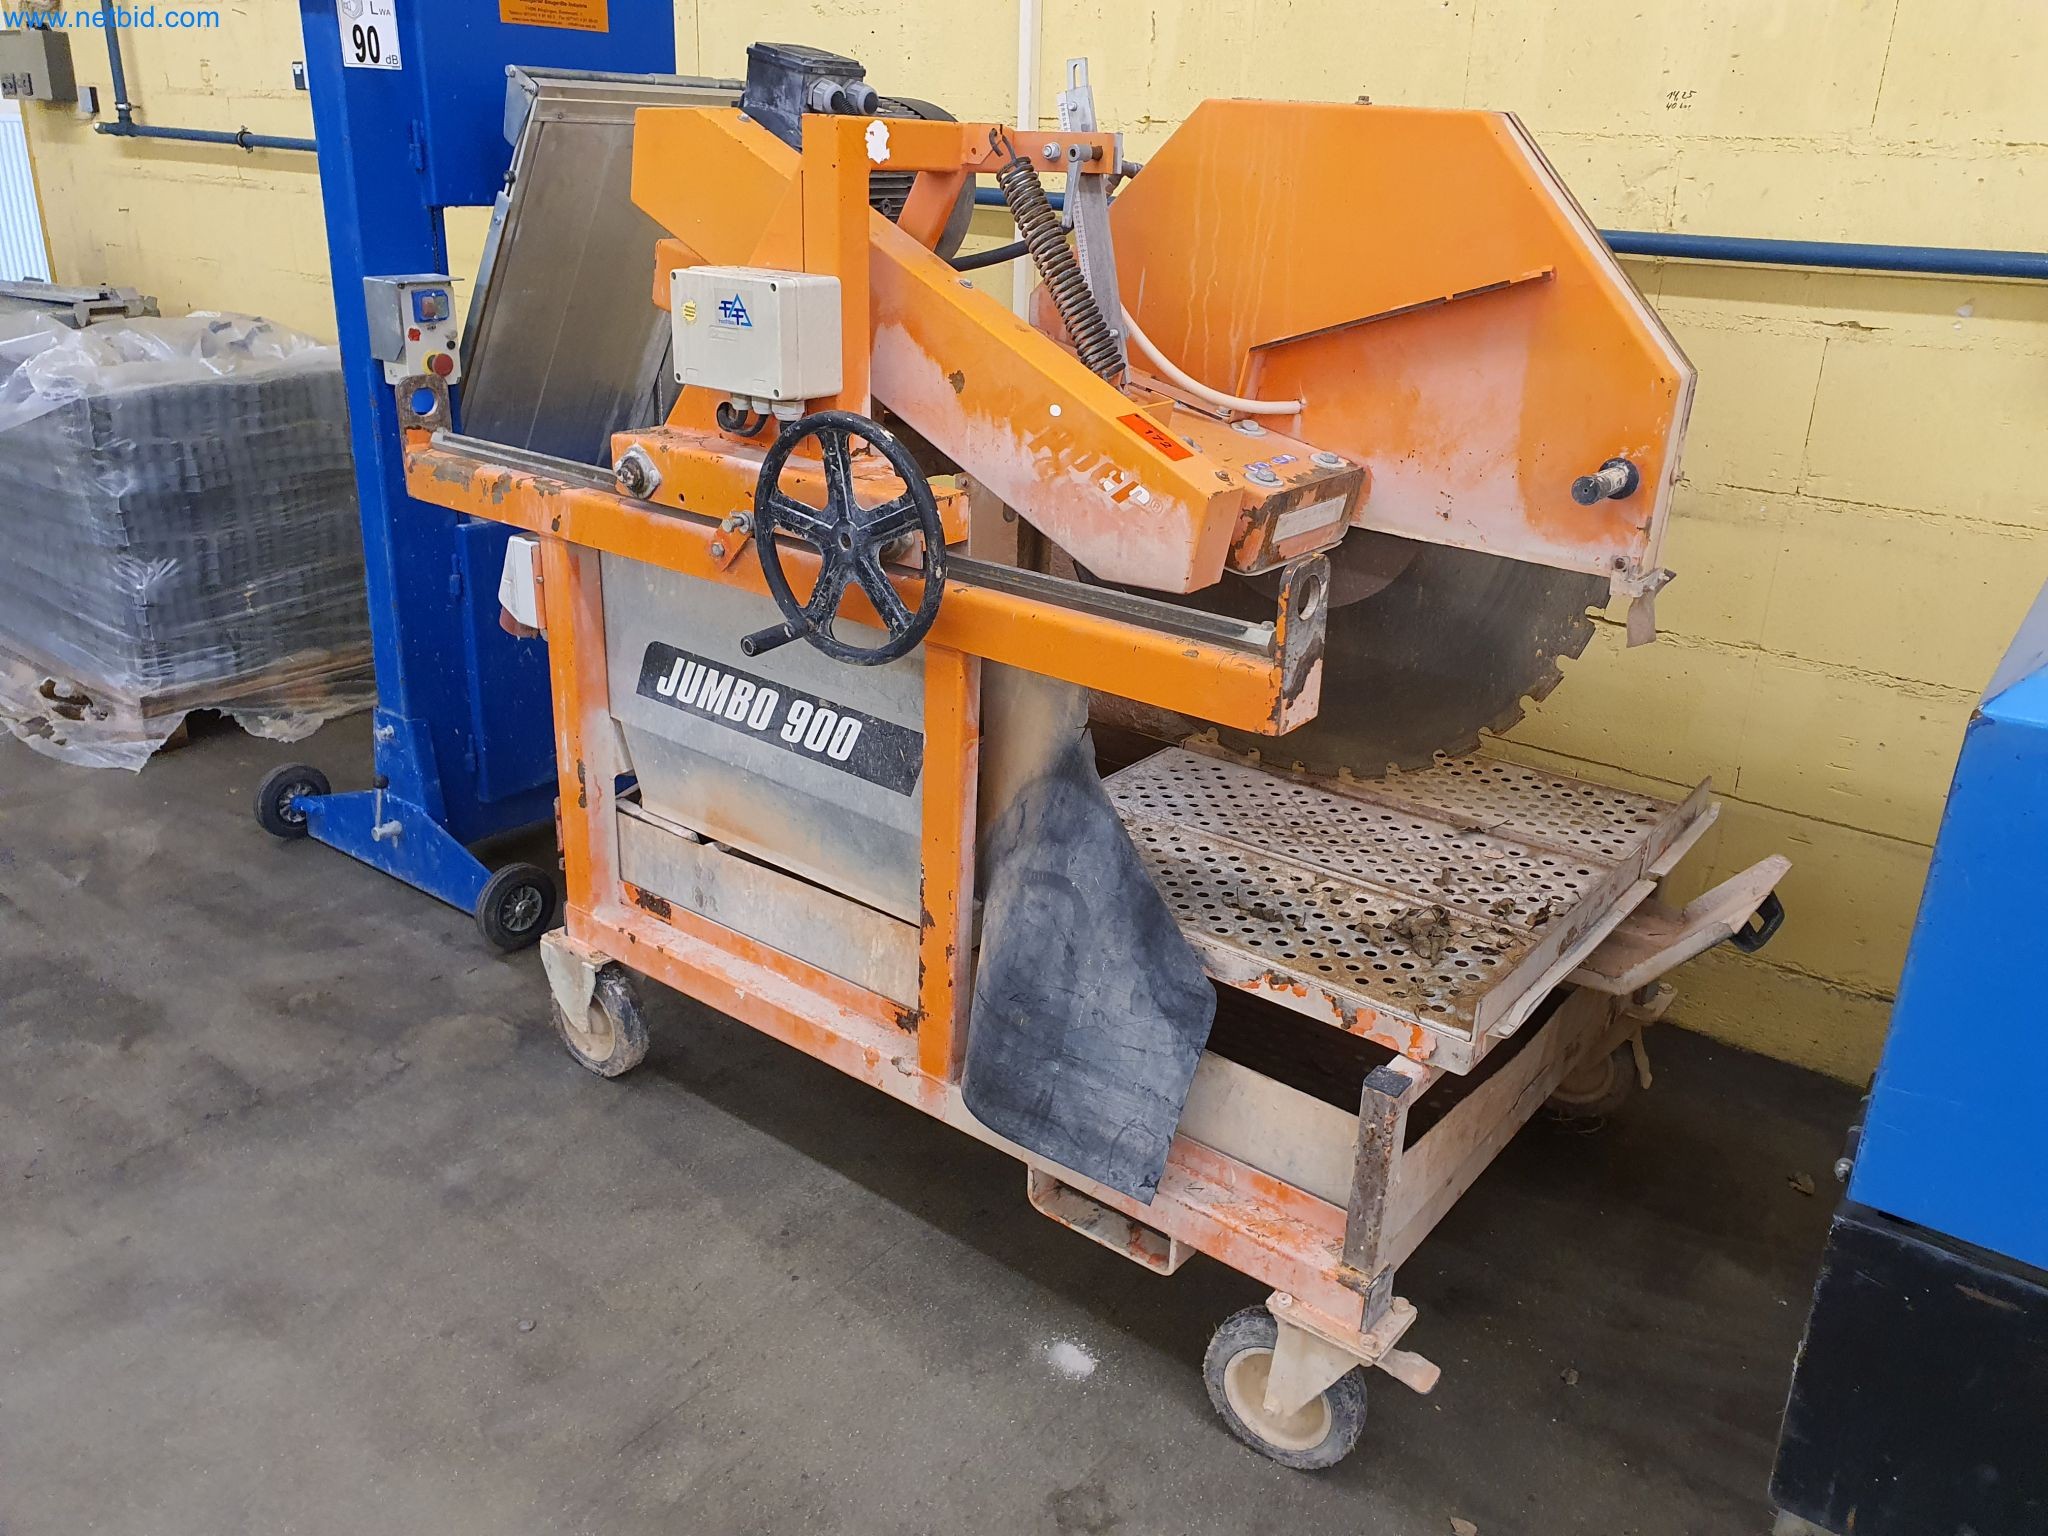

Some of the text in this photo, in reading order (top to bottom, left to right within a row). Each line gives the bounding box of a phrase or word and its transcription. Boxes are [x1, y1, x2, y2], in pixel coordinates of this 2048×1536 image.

[352, 24, 380, 63] 90
[386, 55, 399, 65] dB
[1144, 429, 1173, 449] 172
[656, 657, 862, 762] JUMBO 900
